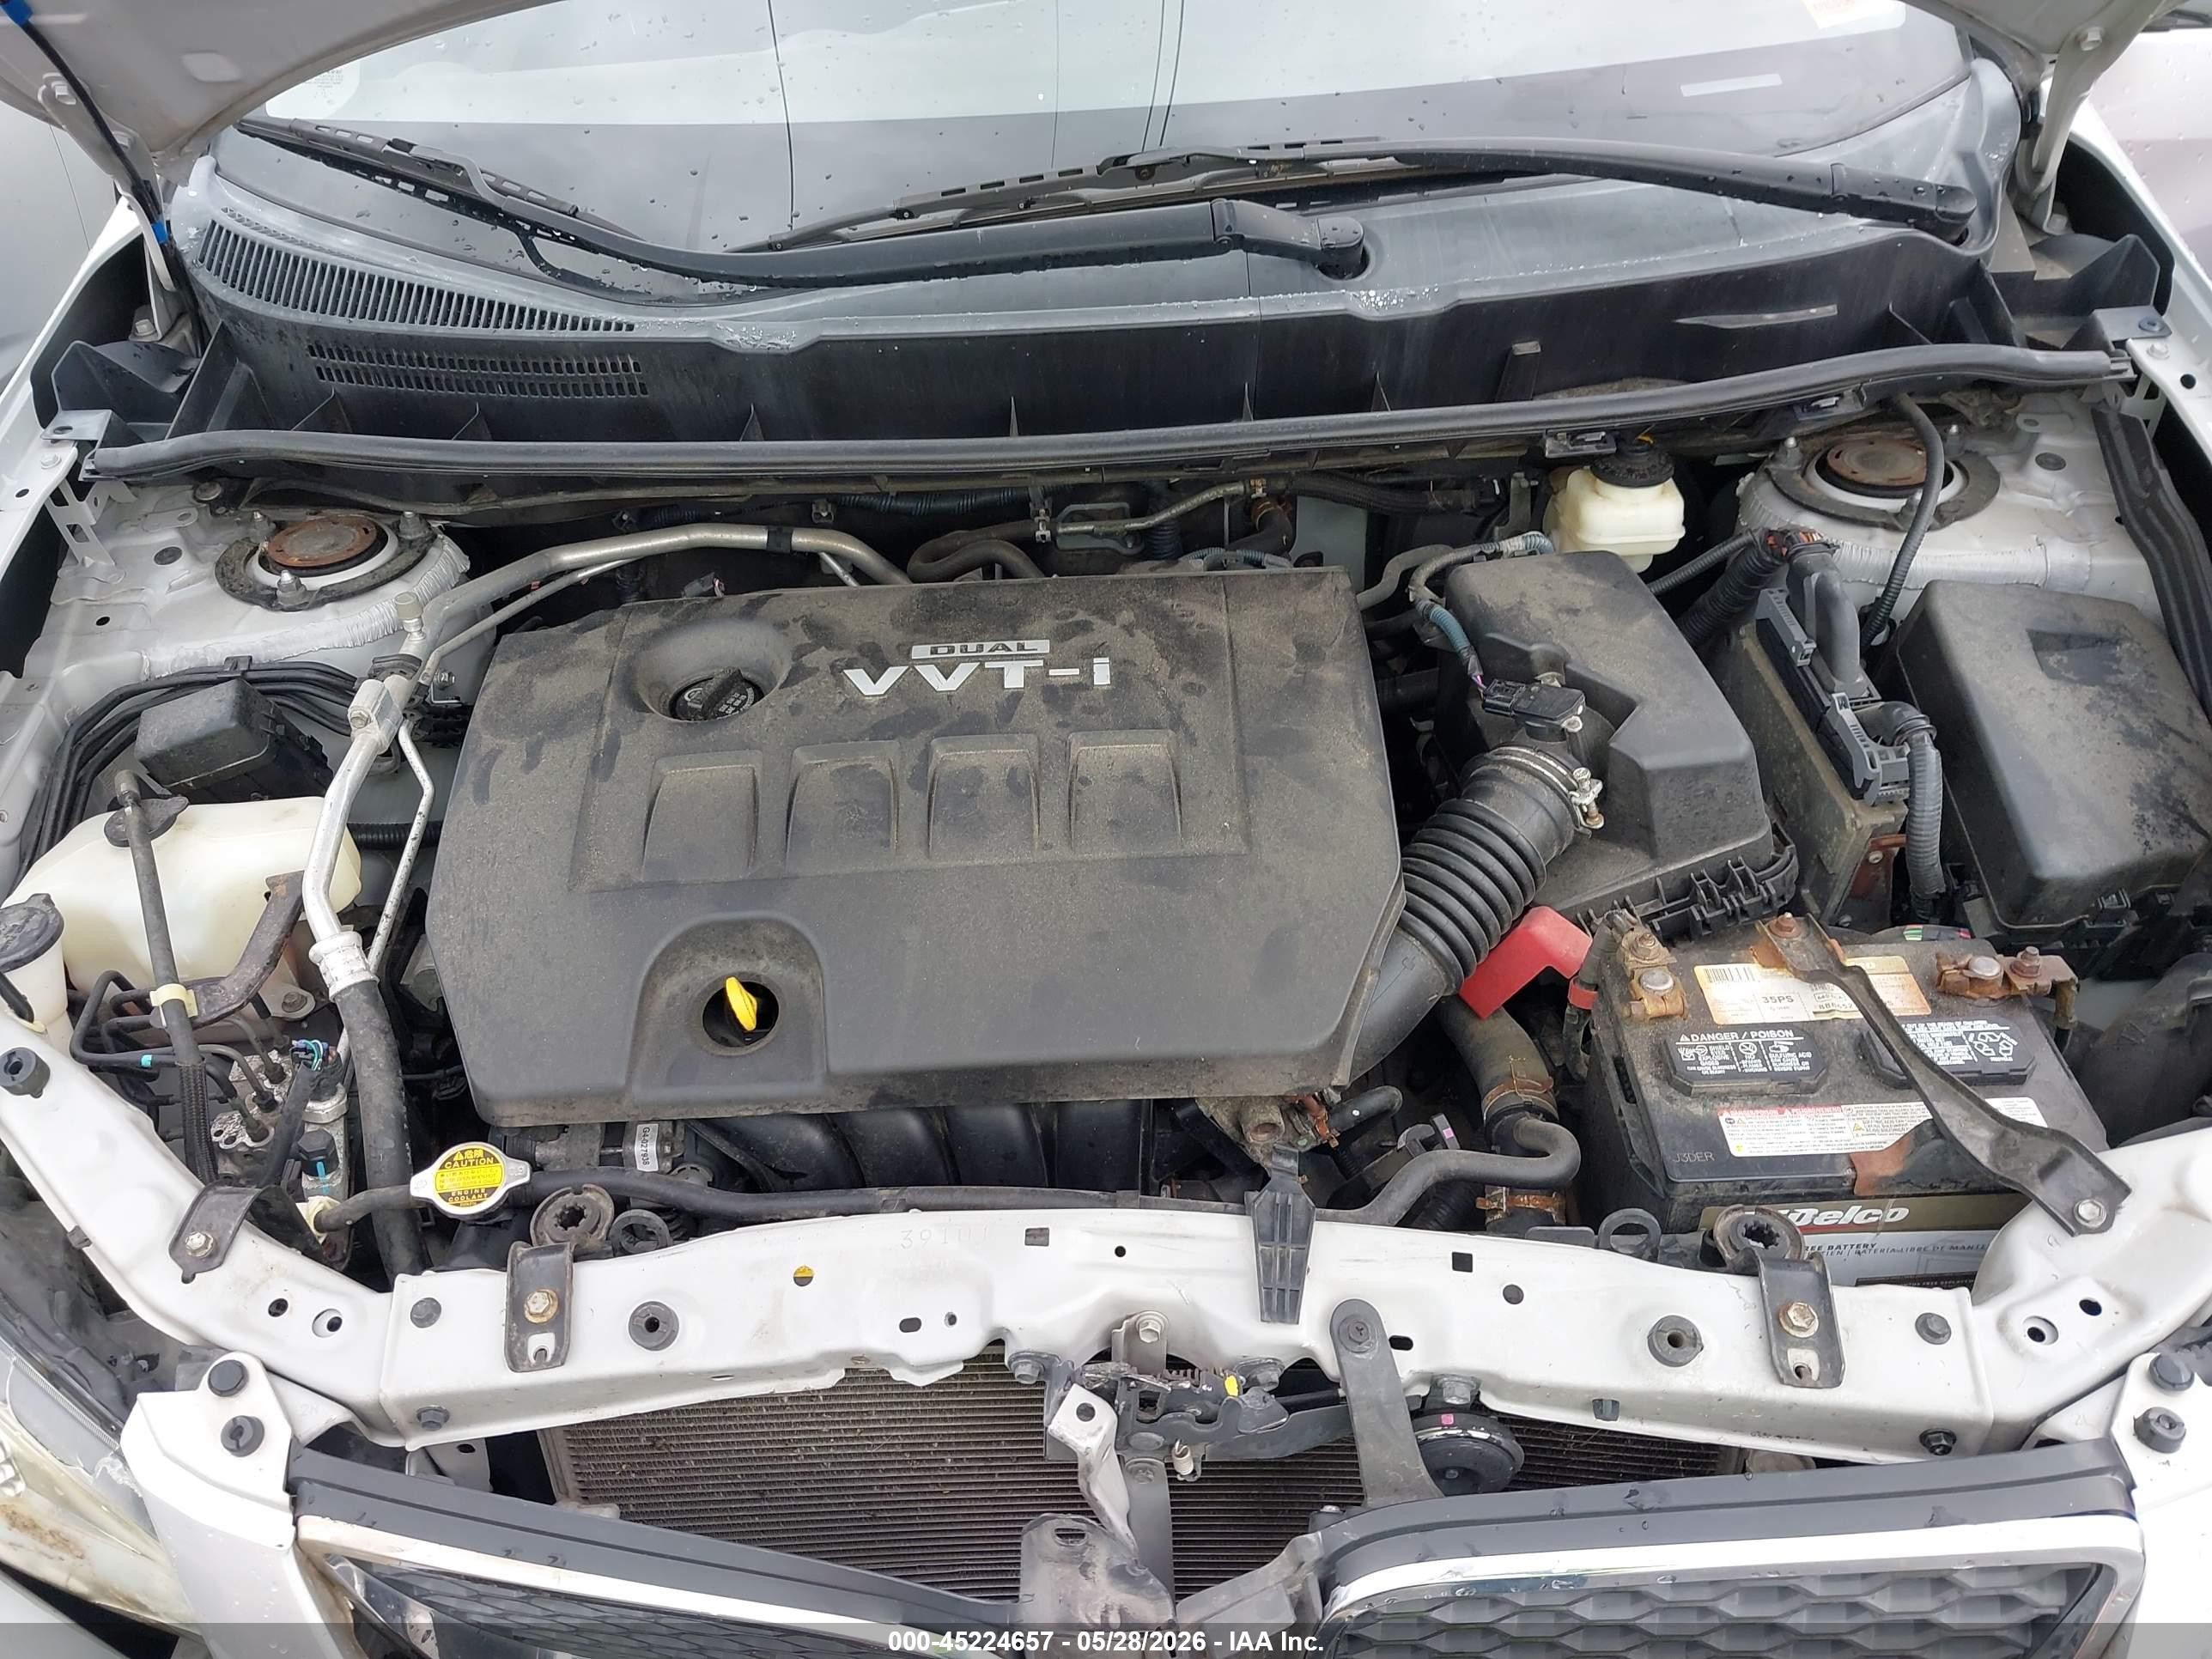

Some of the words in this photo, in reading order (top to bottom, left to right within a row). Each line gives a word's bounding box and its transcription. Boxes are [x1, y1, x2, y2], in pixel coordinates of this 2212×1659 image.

[930, 641, 1038, 655] DUAL
[843, 658, 1111, 696] VVT-i
[1762, 995, 1795, 1004] 35PS
[1691, 1032, 1739, 1042] DANGER
[445, 1158, 494, 1169] CAUTION
[448, 1193, 488, 1202] COOLANT
[452, 1188, 486, 1197] ENGINE
